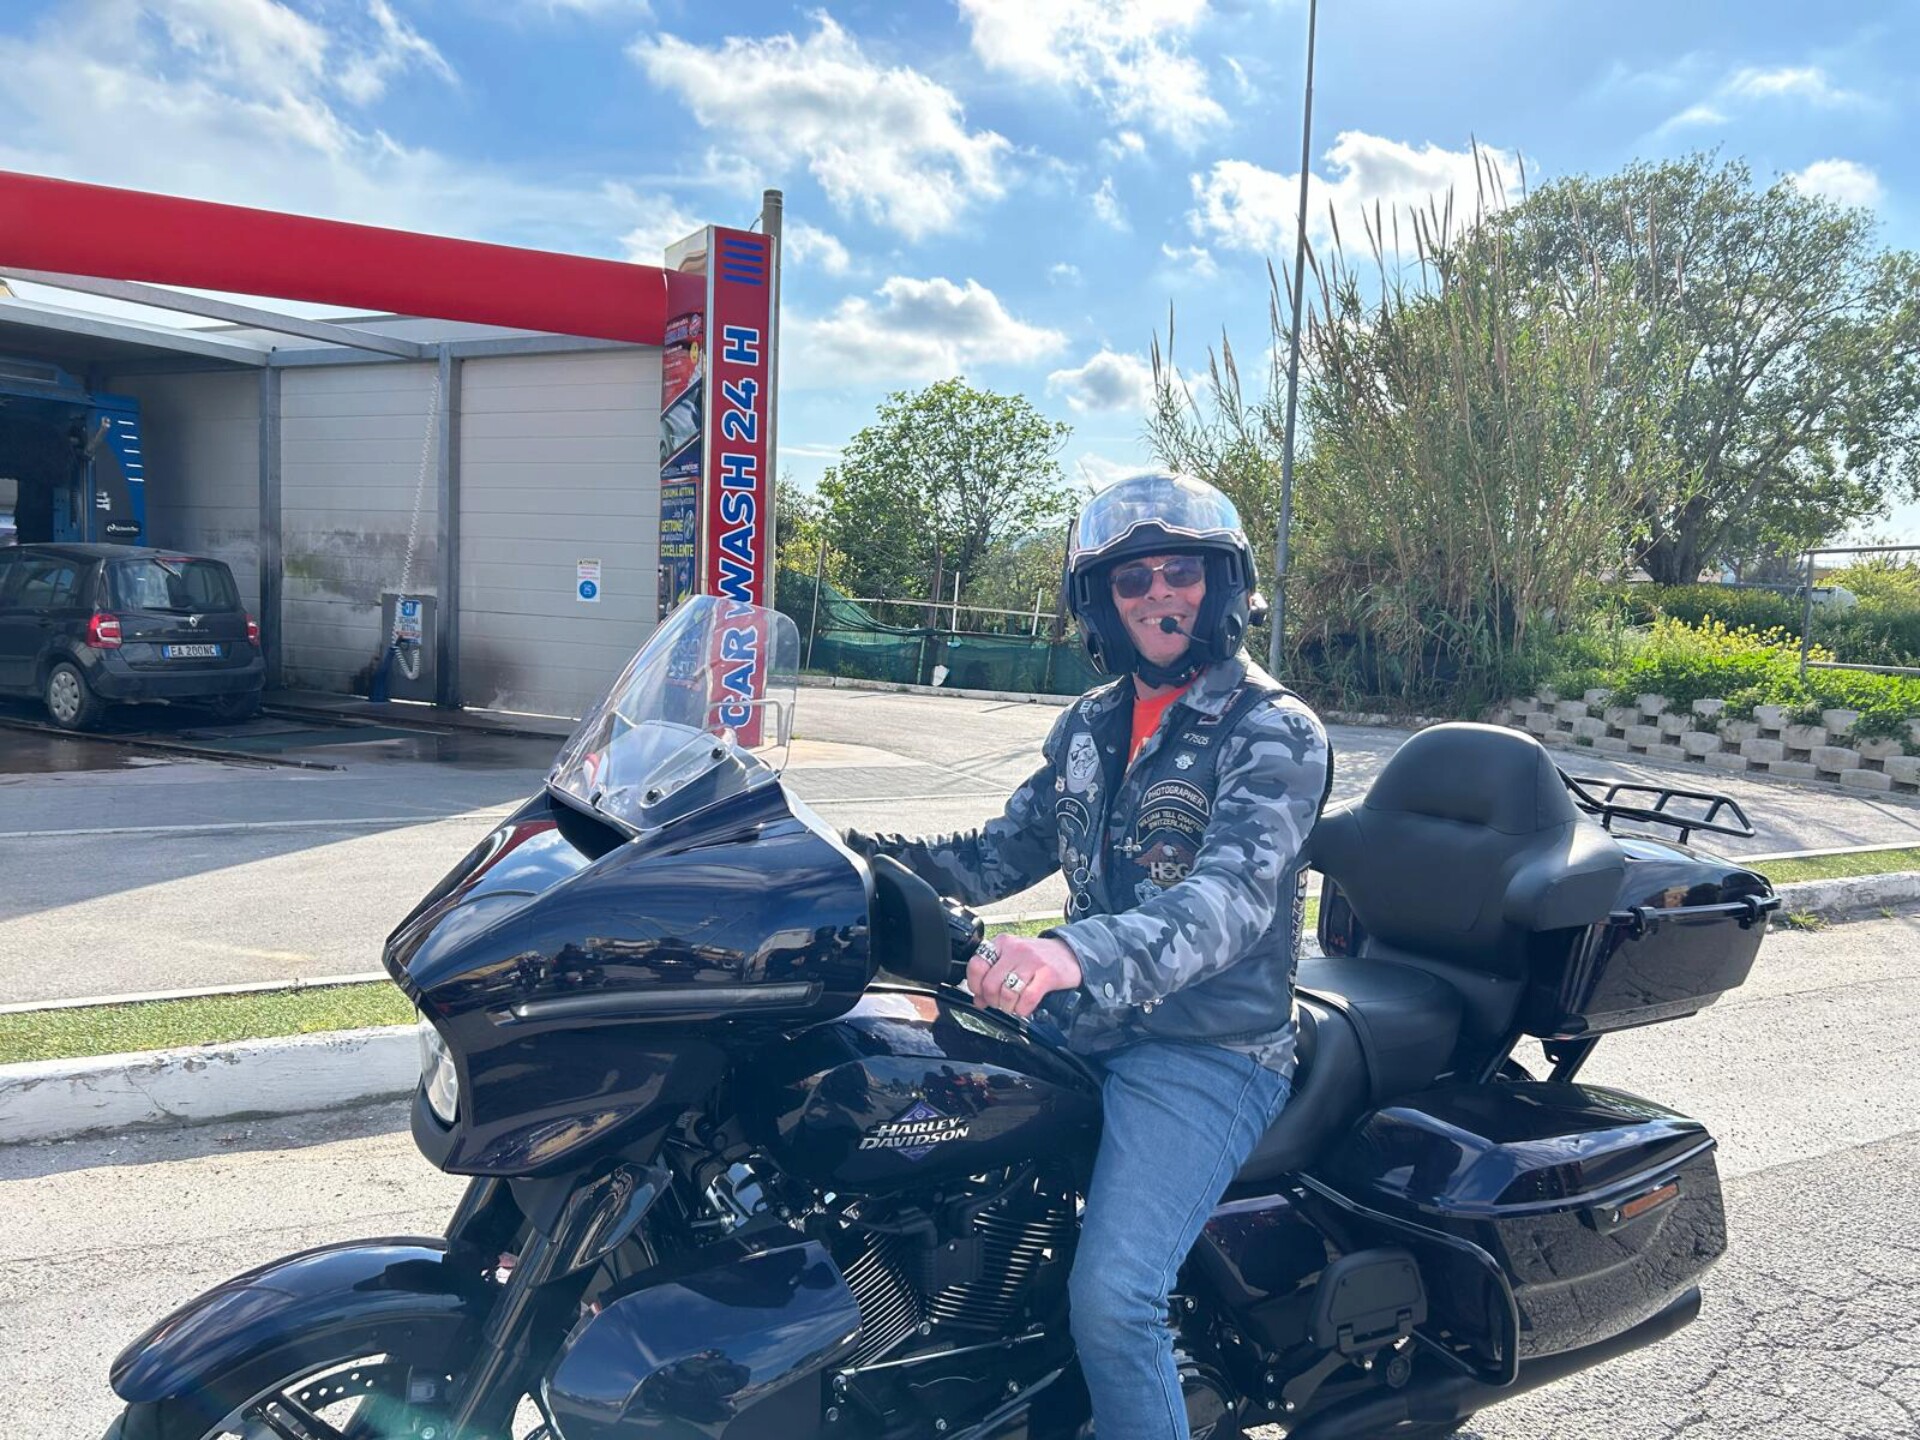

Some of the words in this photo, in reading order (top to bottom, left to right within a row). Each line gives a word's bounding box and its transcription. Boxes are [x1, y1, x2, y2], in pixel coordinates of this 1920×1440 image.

[723, 325, 760, 366] H
[721, 378, 758, 443] 24
[718, 453, 757, 619] WASH
[718, 626, 758, 729] CAR
[1147, 785, 1205, 807] PHOTOGRAPHER
[1148, 818, 1193, 834] SWITZERLAND
[1161, 810, 1177, 819] TELL
[859, 1127, 970, 1150] DAVIDSON
